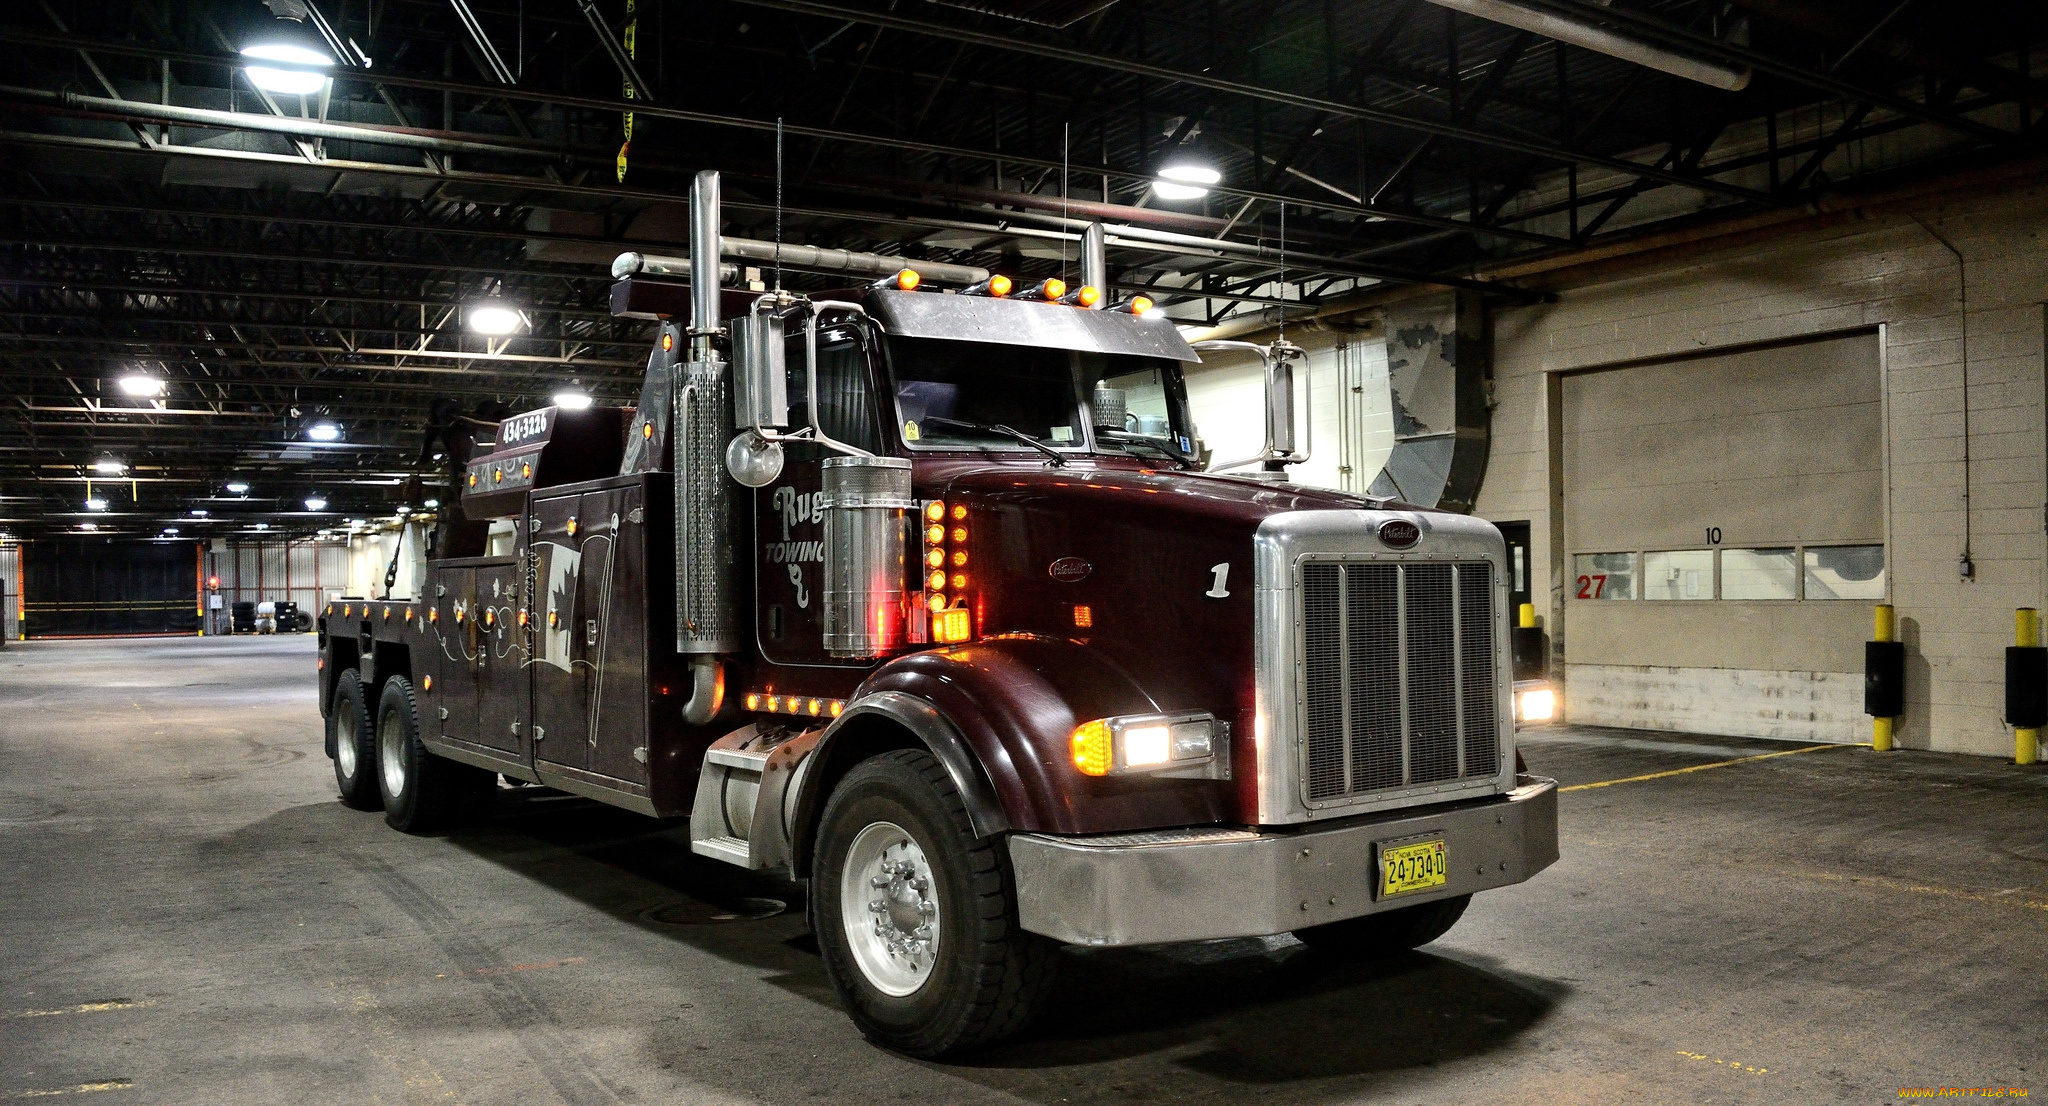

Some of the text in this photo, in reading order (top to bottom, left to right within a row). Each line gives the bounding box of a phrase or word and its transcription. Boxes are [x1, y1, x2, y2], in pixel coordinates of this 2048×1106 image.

[503, 412, 547, 444] 434-3226
[1706, 527, 1722, 545] 10
[1206, 562, 1230, 598] 1
[1577, 574, 1607, 600] 27
